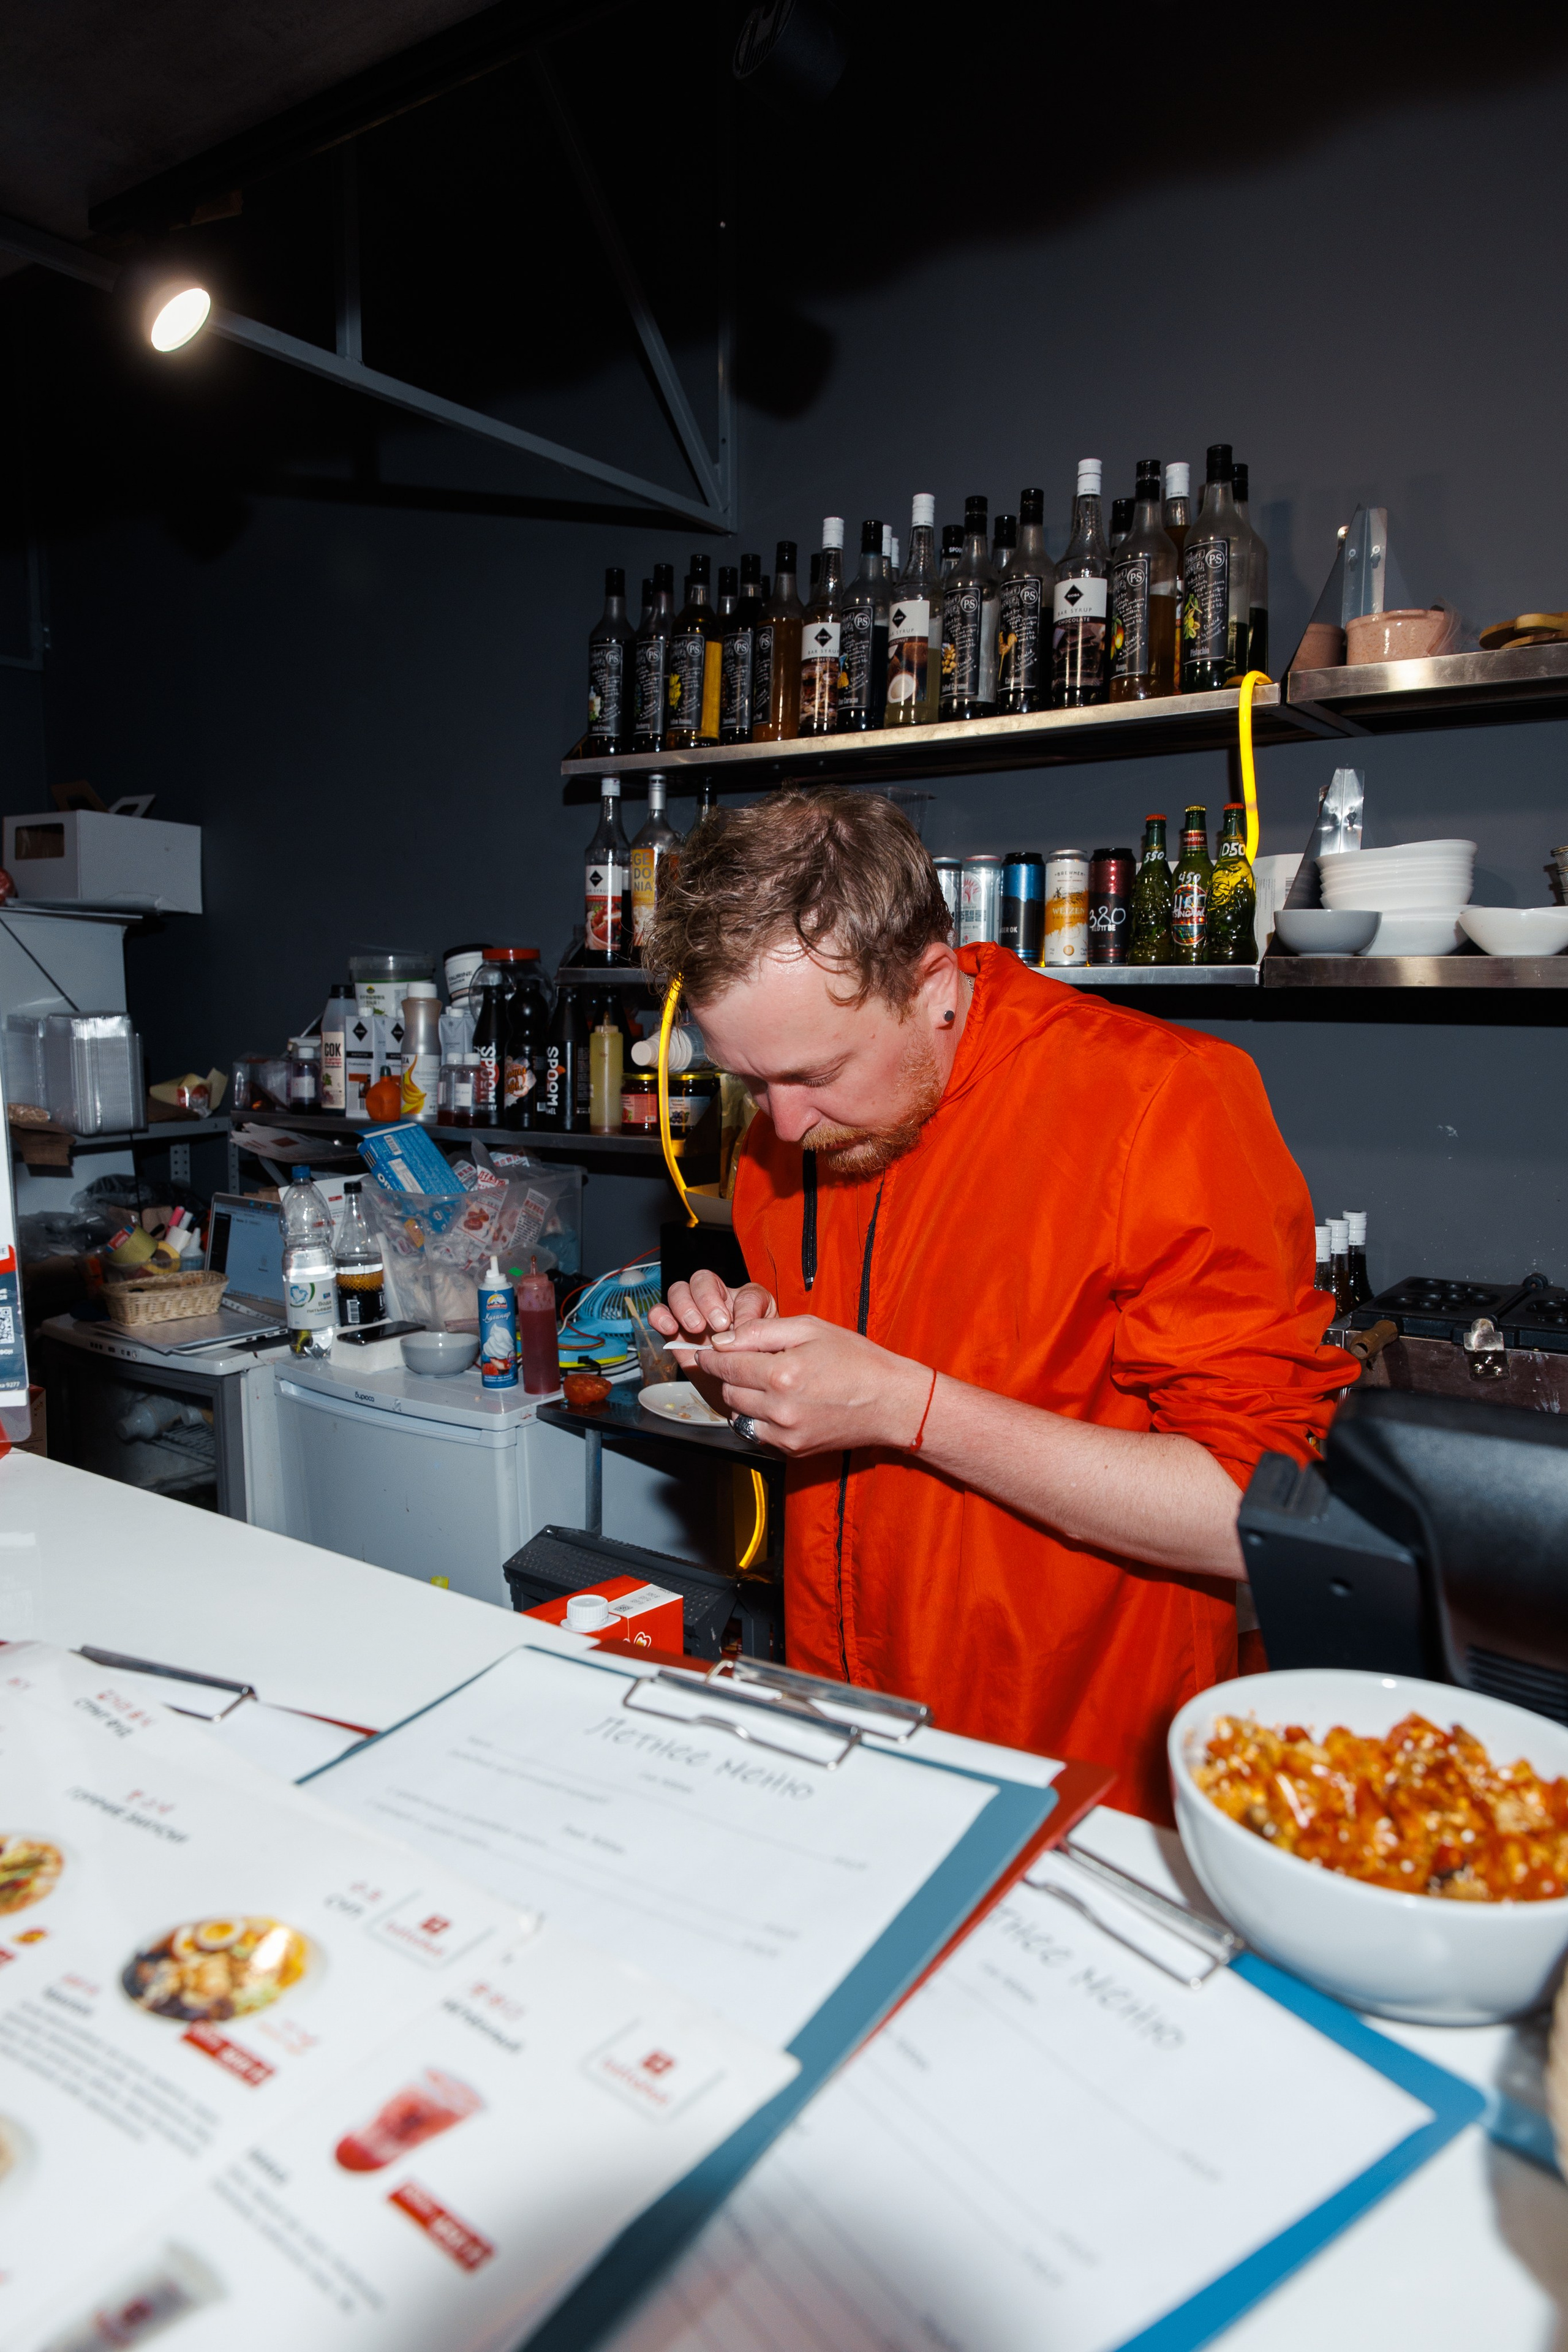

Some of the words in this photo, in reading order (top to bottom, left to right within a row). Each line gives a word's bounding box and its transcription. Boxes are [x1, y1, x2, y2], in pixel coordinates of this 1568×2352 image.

[1058, 617, 1090, 625] CHOCOLATE
[1052, 907, 1086, 916] WEIZEN
[583, 1715, 712, 1769] Летнее
[713, 1757, 815, 1802] меню
